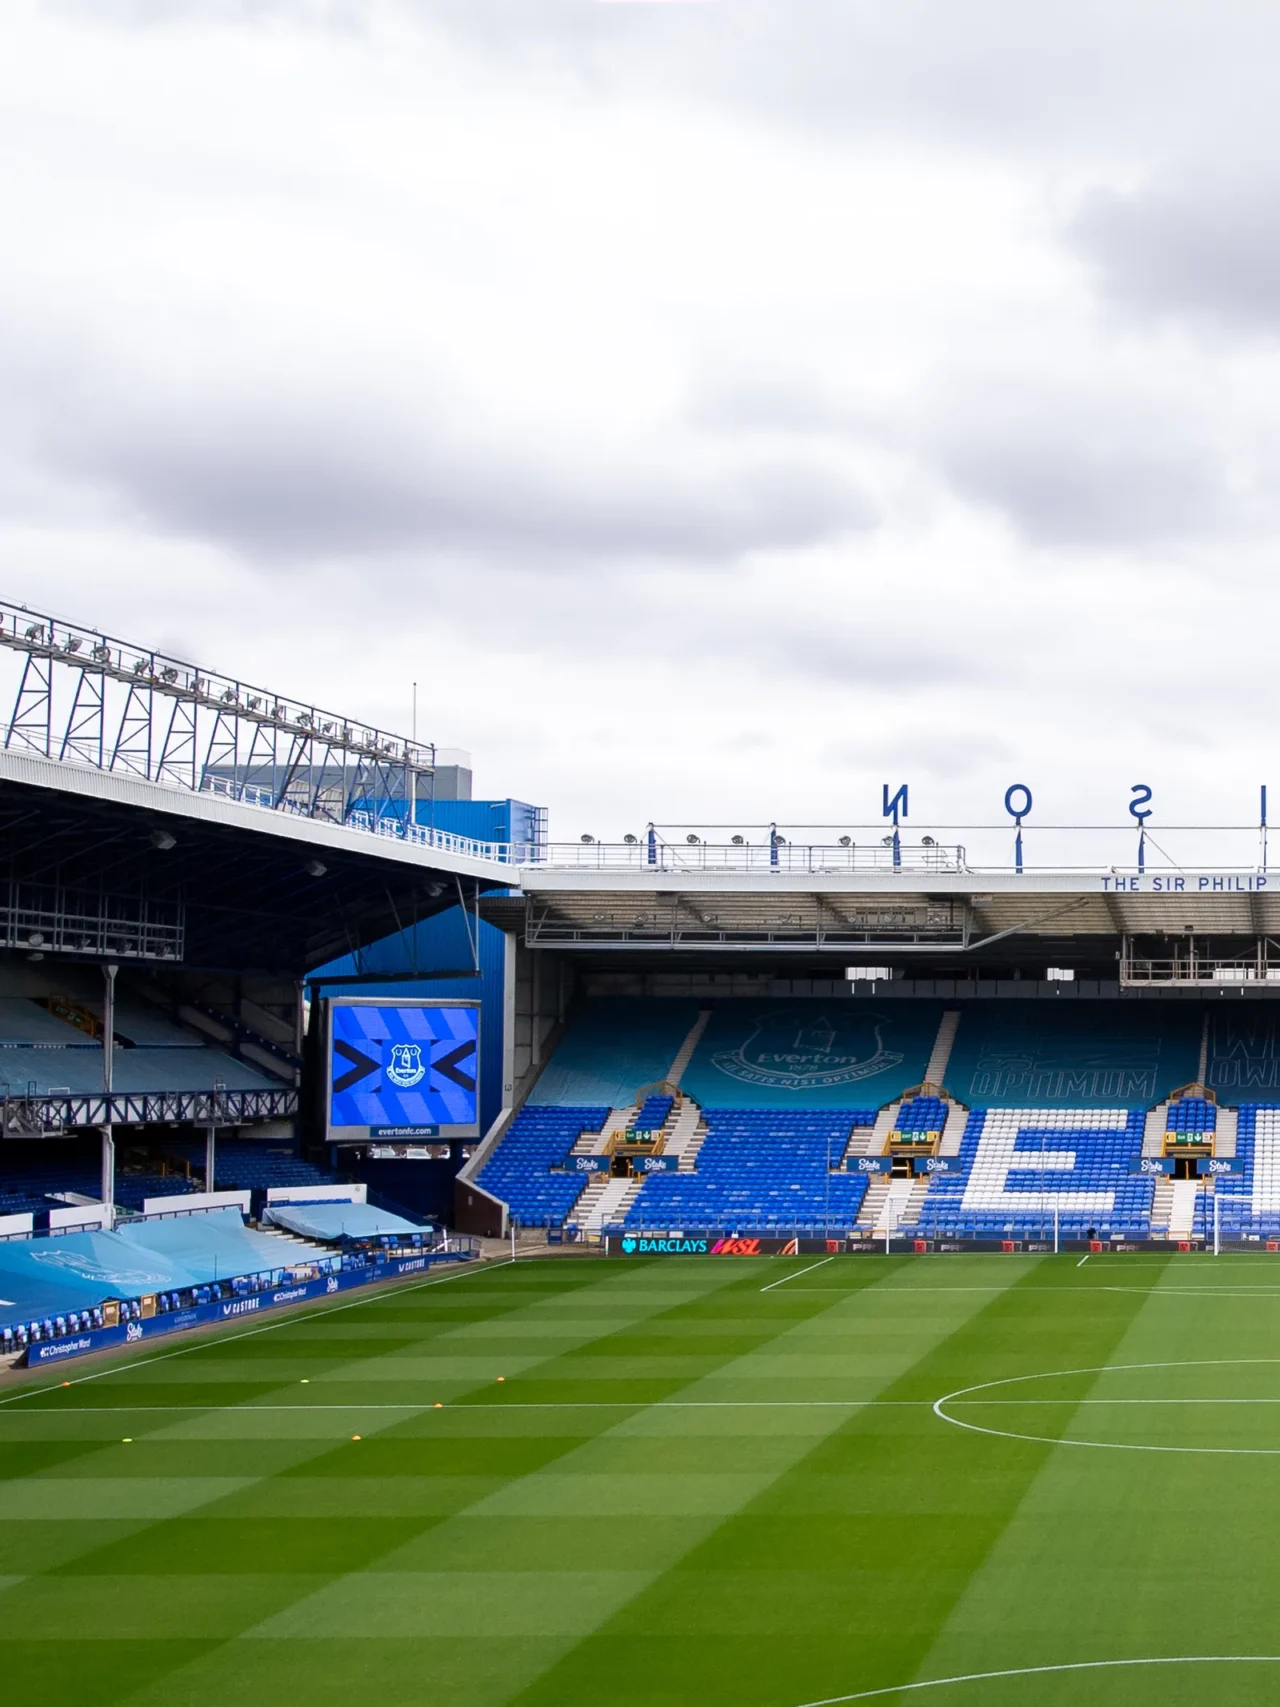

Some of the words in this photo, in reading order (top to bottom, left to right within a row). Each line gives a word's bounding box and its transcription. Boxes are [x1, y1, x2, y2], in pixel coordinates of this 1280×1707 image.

[1102, 878, 1139, 891] THE
[1153, 878, 1185, 891] SIR
[1199, 878, 1266, 891] PHILIP
[756, 1052, 857, 1064] Everton
[969, 1071, 1157, 1098] OPTIMUM
[378, 1127, 431, 1136] evertonfc.com
[576, 1157, 598, 1170] Stake
[644, 1157, 666, 1170] Stake
[858, 1158, 880, 1170] Stake
[926, 1158, 948, 1170] Stake
[1209, 1159, 1231, 1172] Stake
[639, 1239, 706, 1252] BARCLAYS
[710, 1239, 761, 1255] WSL
[232, 1298, 259, 1314] CASTORE
[50, 1341, 78, 1356] Christopher
[78, 1338, 91, 1349] Ward
